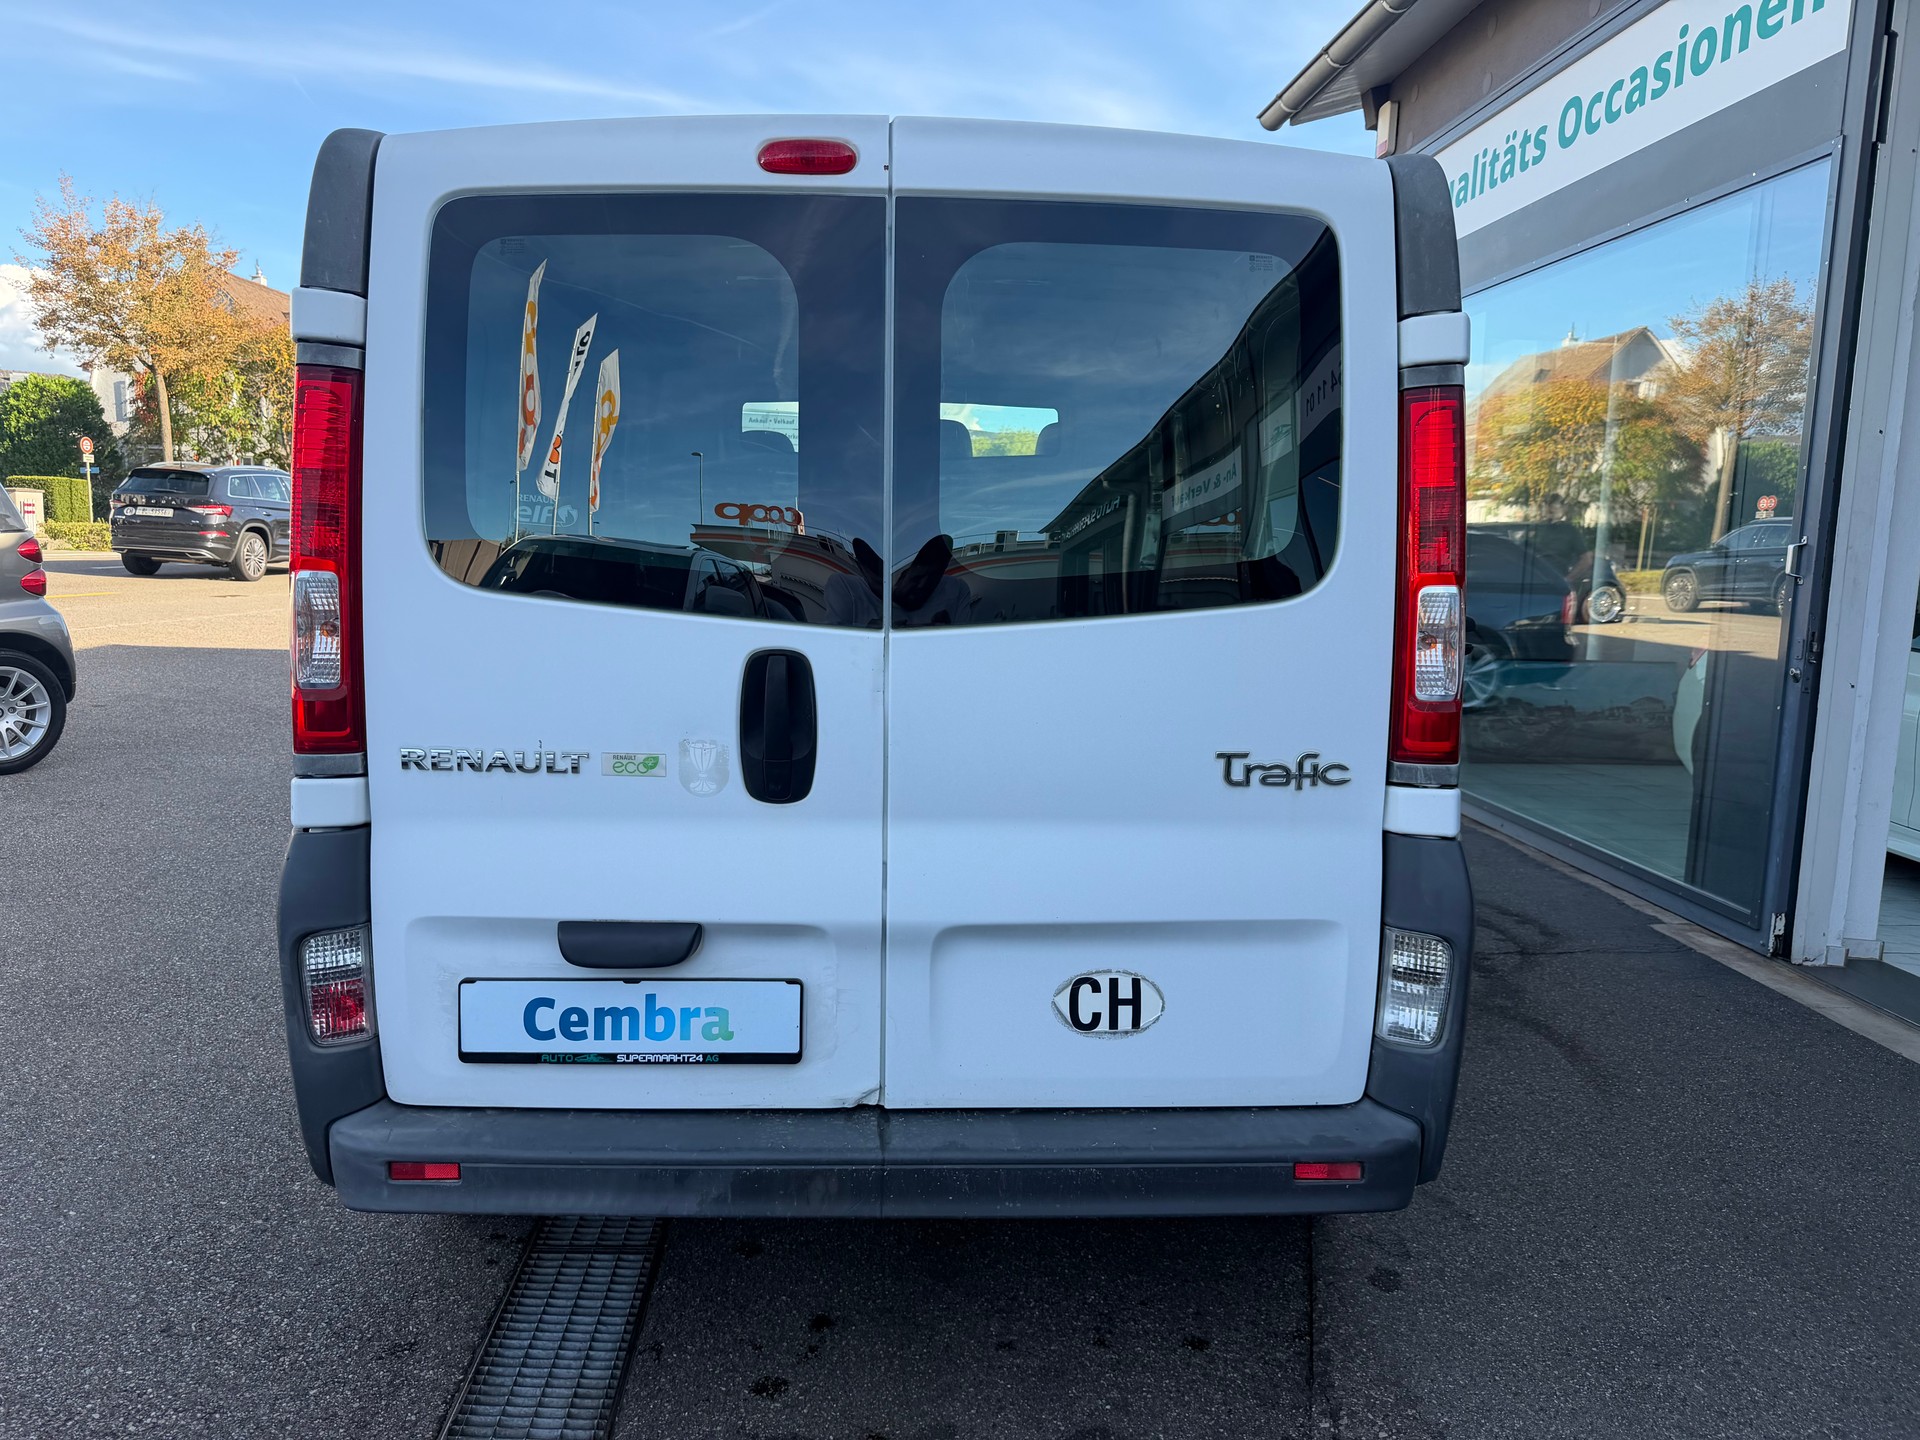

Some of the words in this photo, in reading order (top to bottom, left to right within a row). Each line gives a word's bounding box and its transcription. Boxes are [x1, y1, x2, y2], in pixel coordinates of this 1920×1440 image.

[1450, 124, 1547, 208] alitäts
[518, 494, 558, 505] RENAUL
[400, 747, 590, 775] RENAULT
[1215, 751, 1351, 791] Trafic
[523, 993, 735, 1042] Cembra
[1068, 976, 1142, 1031] CH
[541, 1053, 574, 1063] AUTO
[616, 1053, 703, 1063] SUPERMARKT24
[705, 1054, 719, 1063] AG
